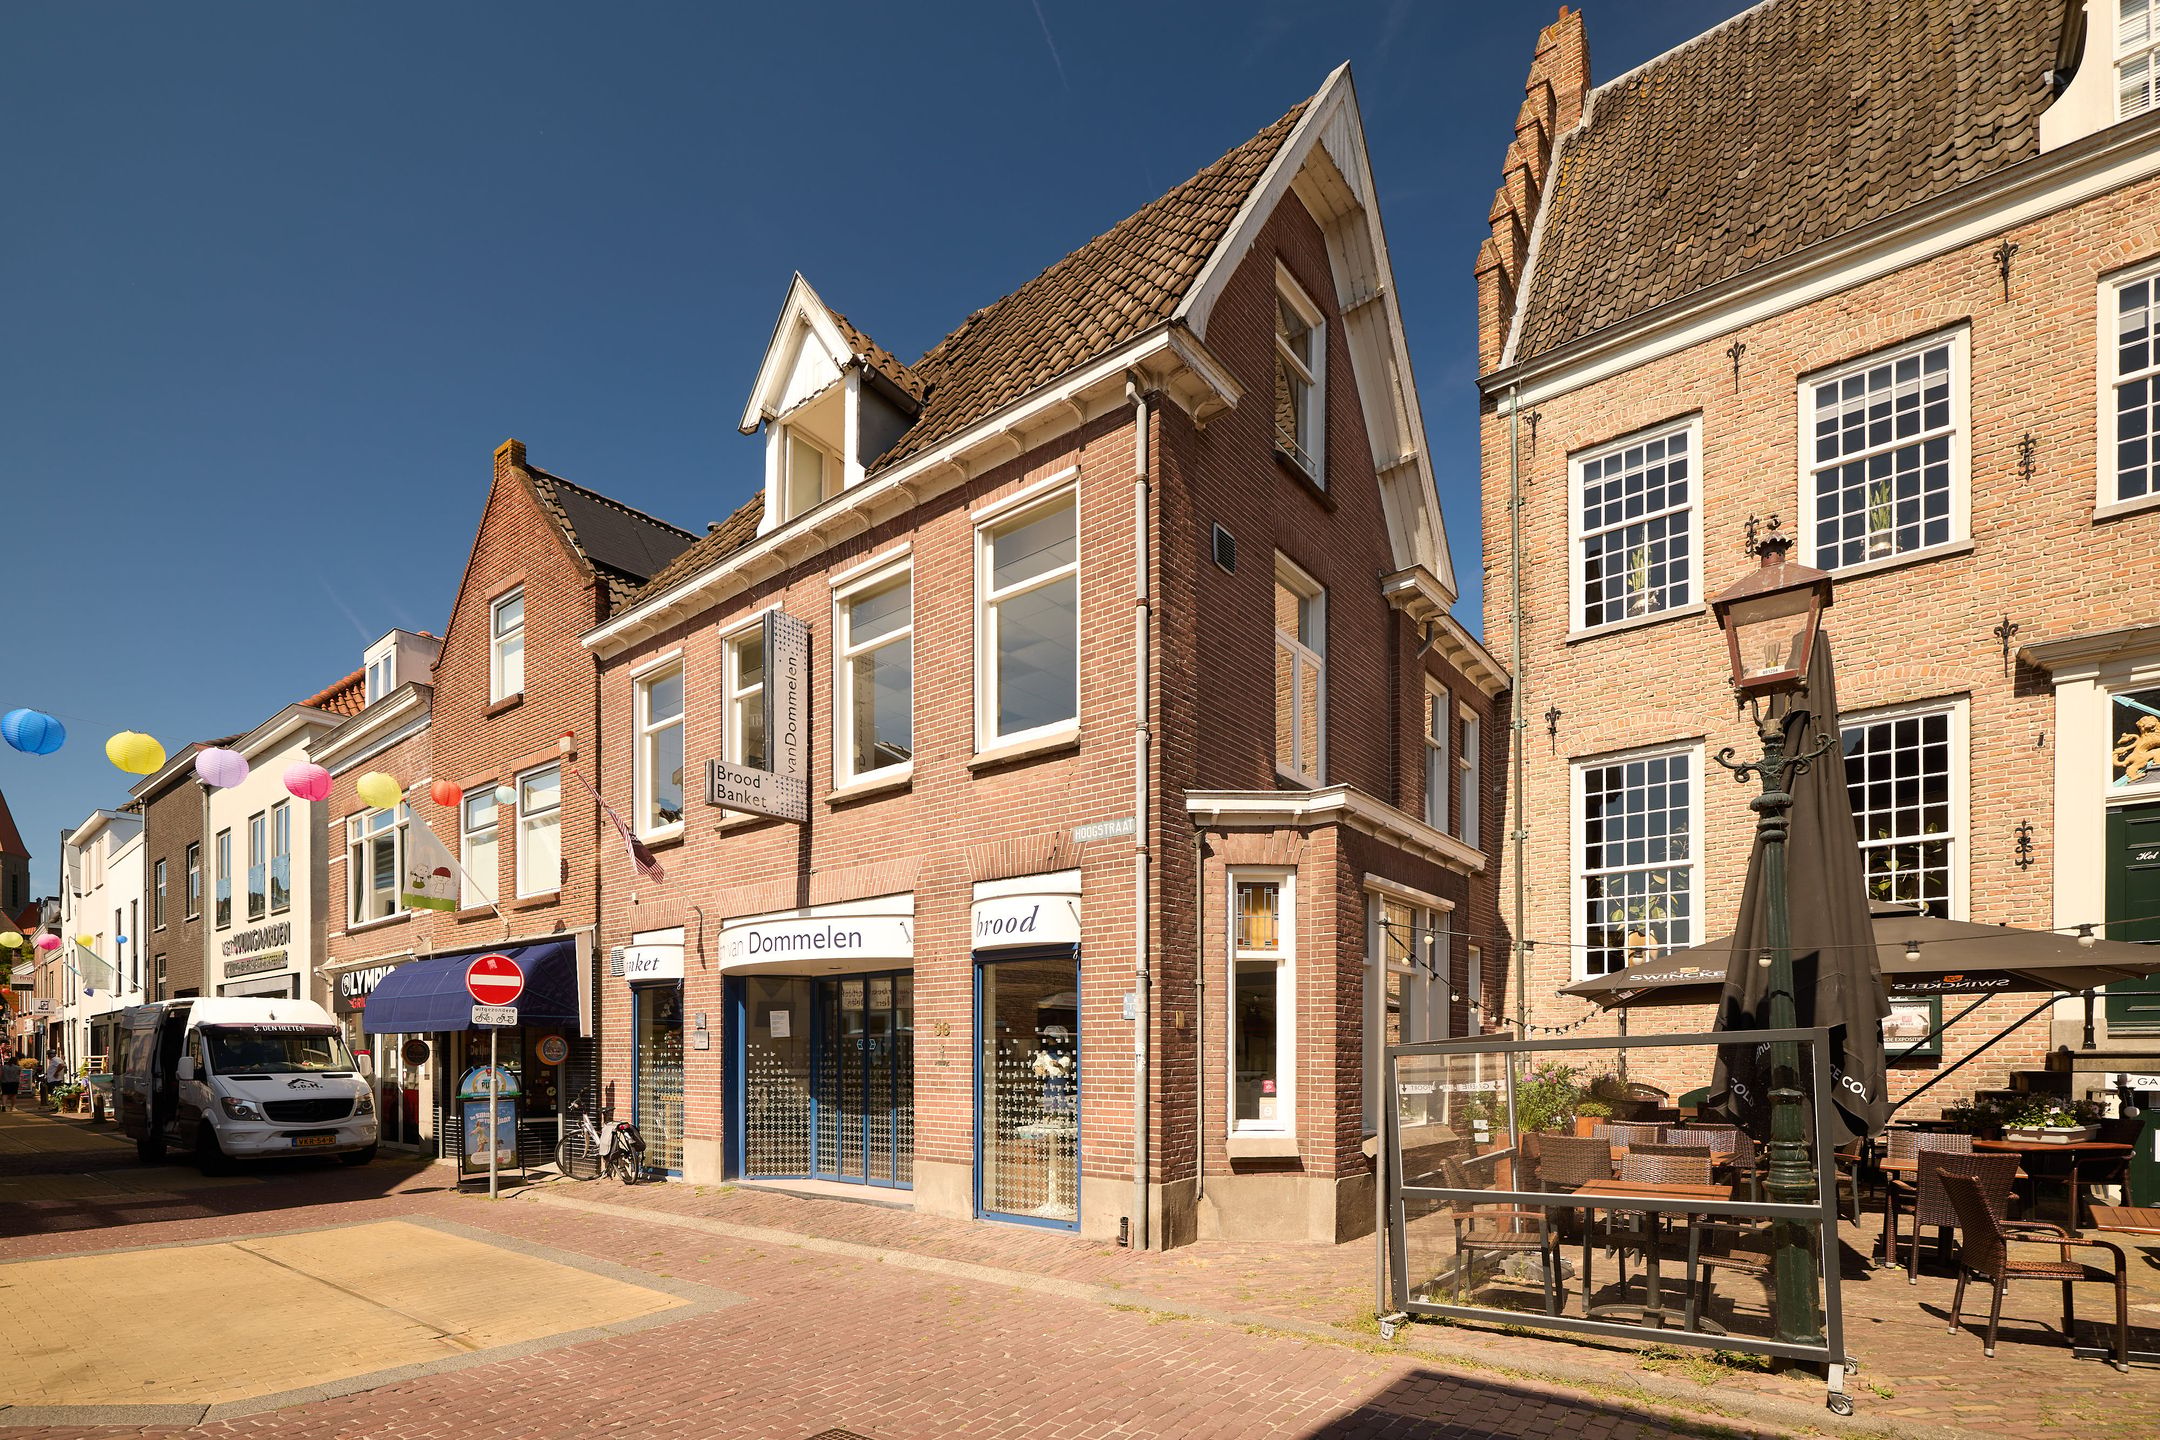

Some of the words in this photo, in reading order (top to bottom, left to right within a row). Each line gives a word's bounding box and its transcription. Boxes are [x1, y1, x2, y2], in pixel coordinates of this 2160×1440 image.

[717, 765, 761, 789] Brood
[717, 783, 767, 808] Banket
[1075, 819, 1133, 840] HOOGSTRAAT
[976, 904, 1040, 938] brood
[749, 925, 862, 954] Dommelen
[626, 953, 660, 973] nket
[1842, 1075, 1868, 1104] COL
